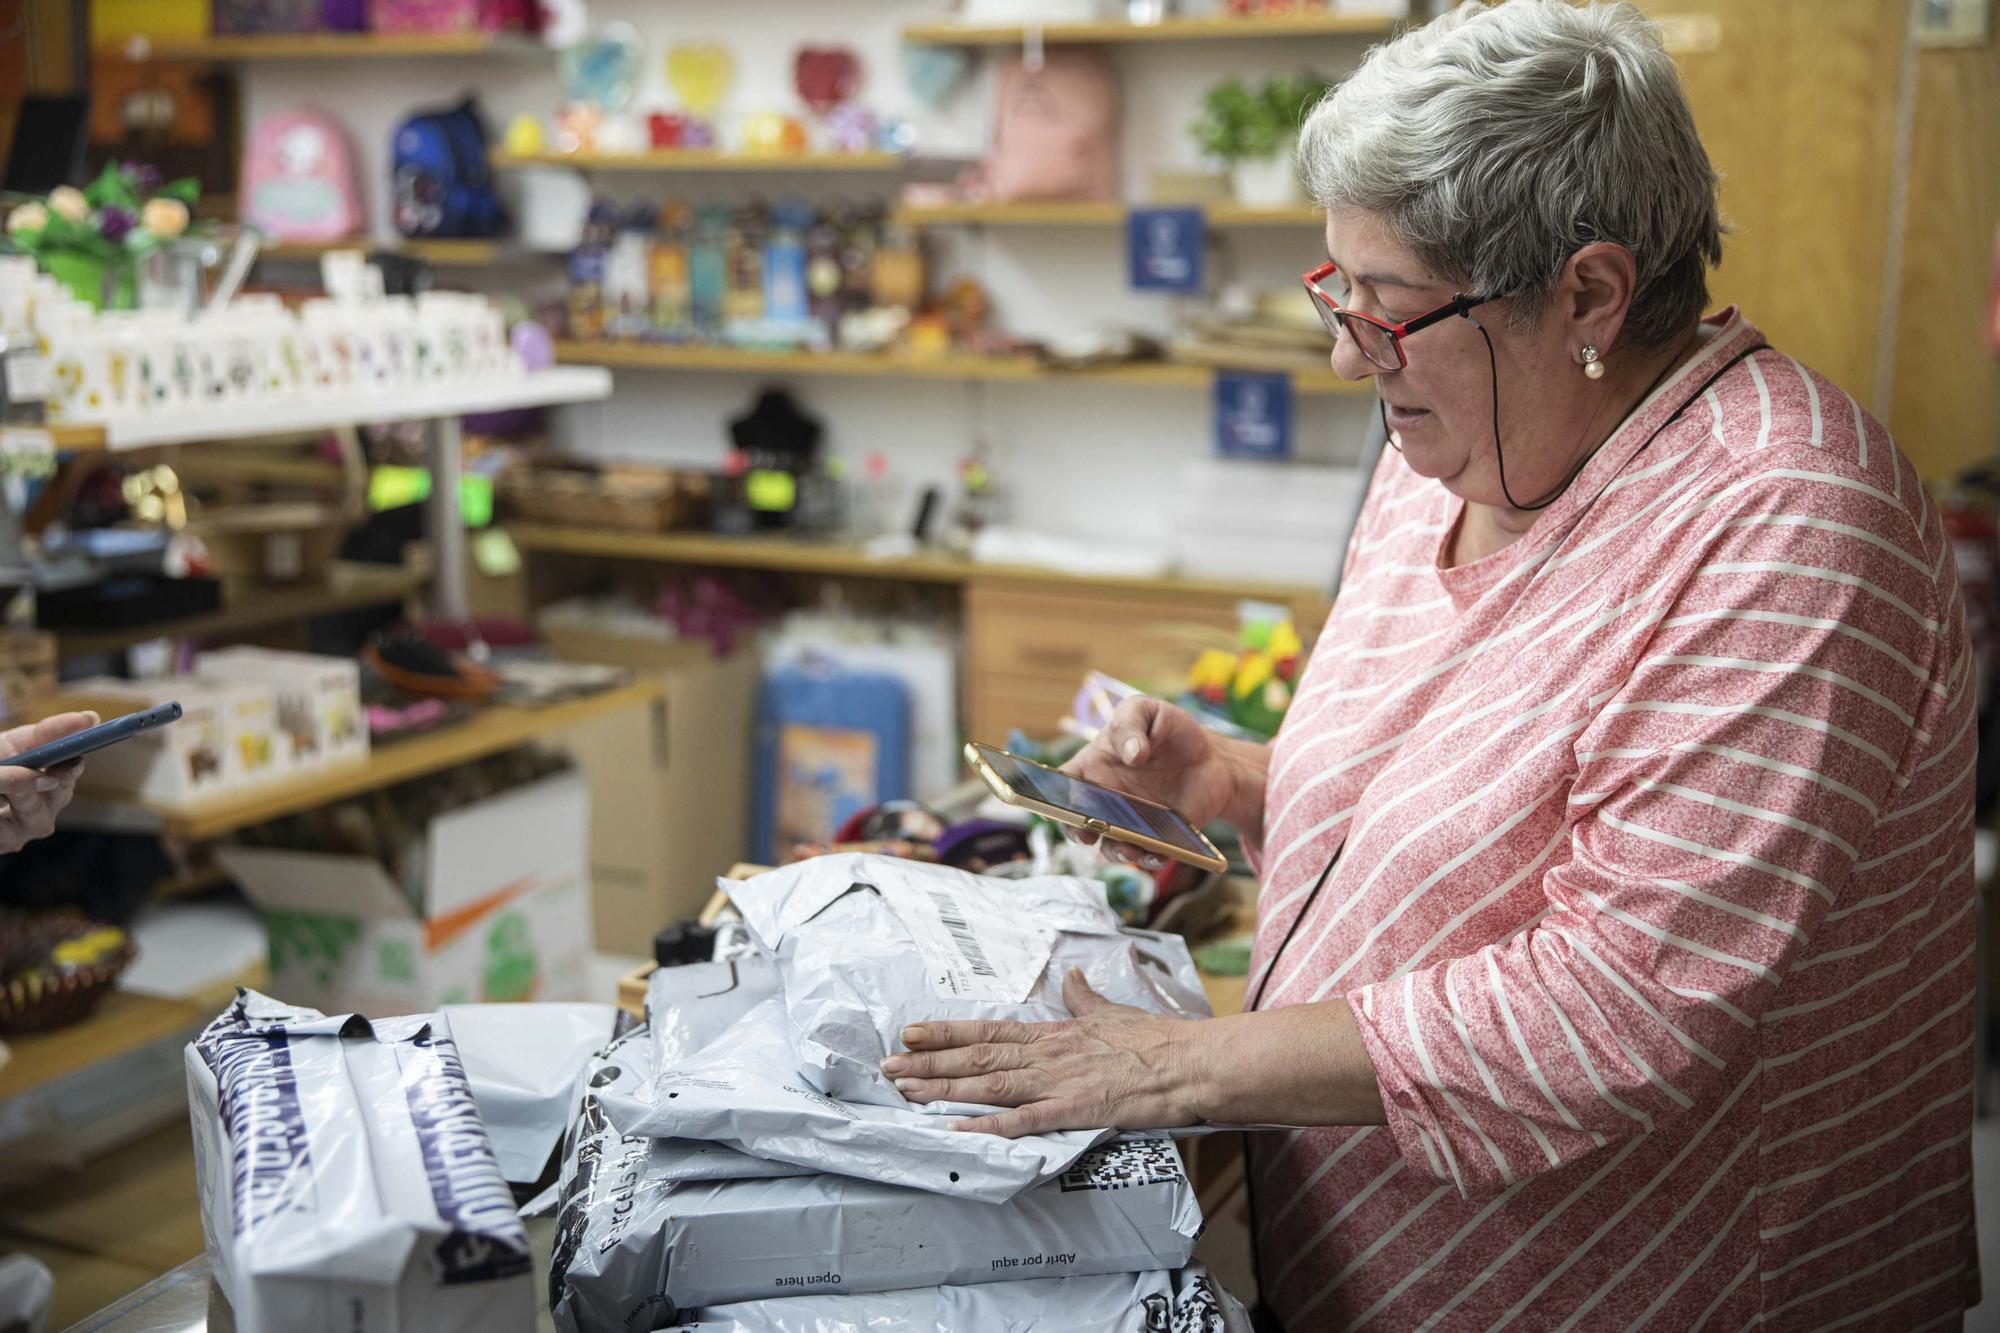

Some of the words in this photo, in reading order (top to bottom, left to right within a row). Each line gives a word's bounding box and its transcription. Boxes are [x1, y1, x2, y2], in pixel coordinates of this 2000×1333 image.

[600, 1171, 638, 1255] Parcels
[991, 1256, 1020, 1271] aquí
[1021, 1253, 1043, 1266] por
[1045, 1252, 1076, 1265] Abrir
[775, 1276, 804, 1286] here
[807, 1271, 842, 1284] Open
